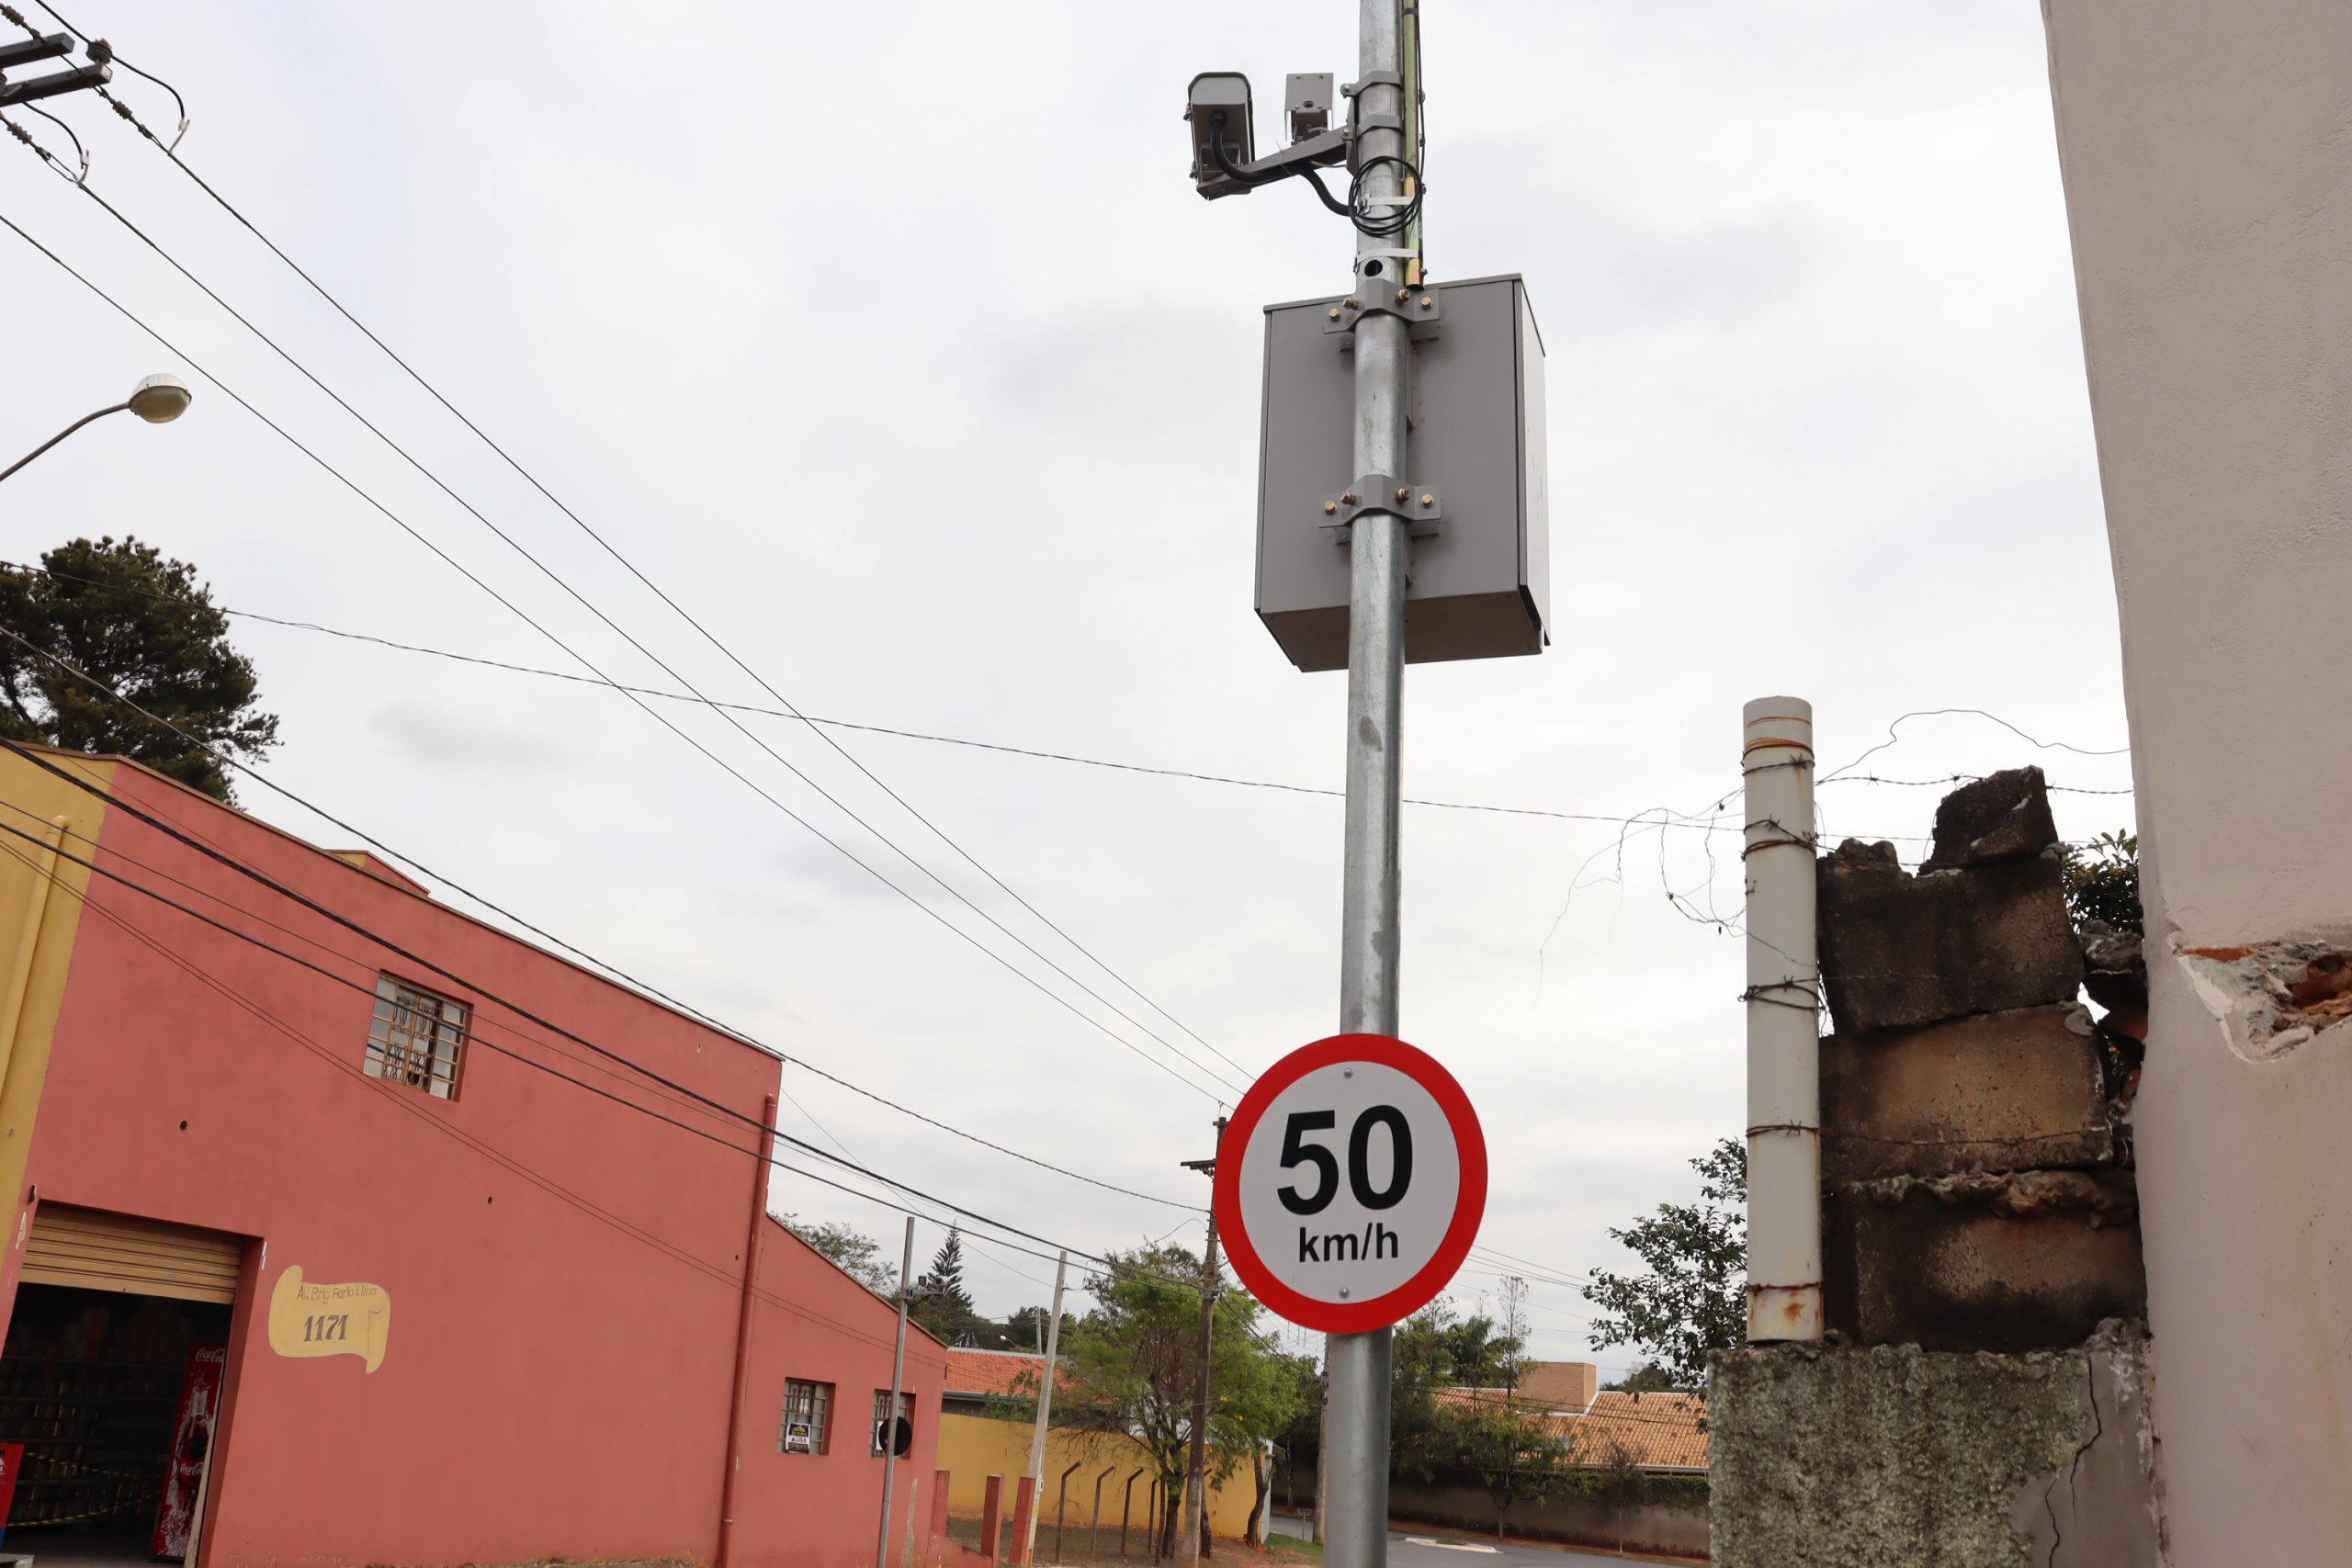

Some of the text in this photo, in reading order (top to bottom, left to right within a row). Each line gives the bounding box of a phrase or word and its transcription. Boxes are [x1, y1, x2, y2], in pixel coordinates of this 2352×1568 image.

[1277, 1105, 1413, 1216] 50
[1299, 1223, 1398, 1263] km/h
[332, 1286, 354, 1300] Faria
[303, 1314, 349, 1342] 1171
